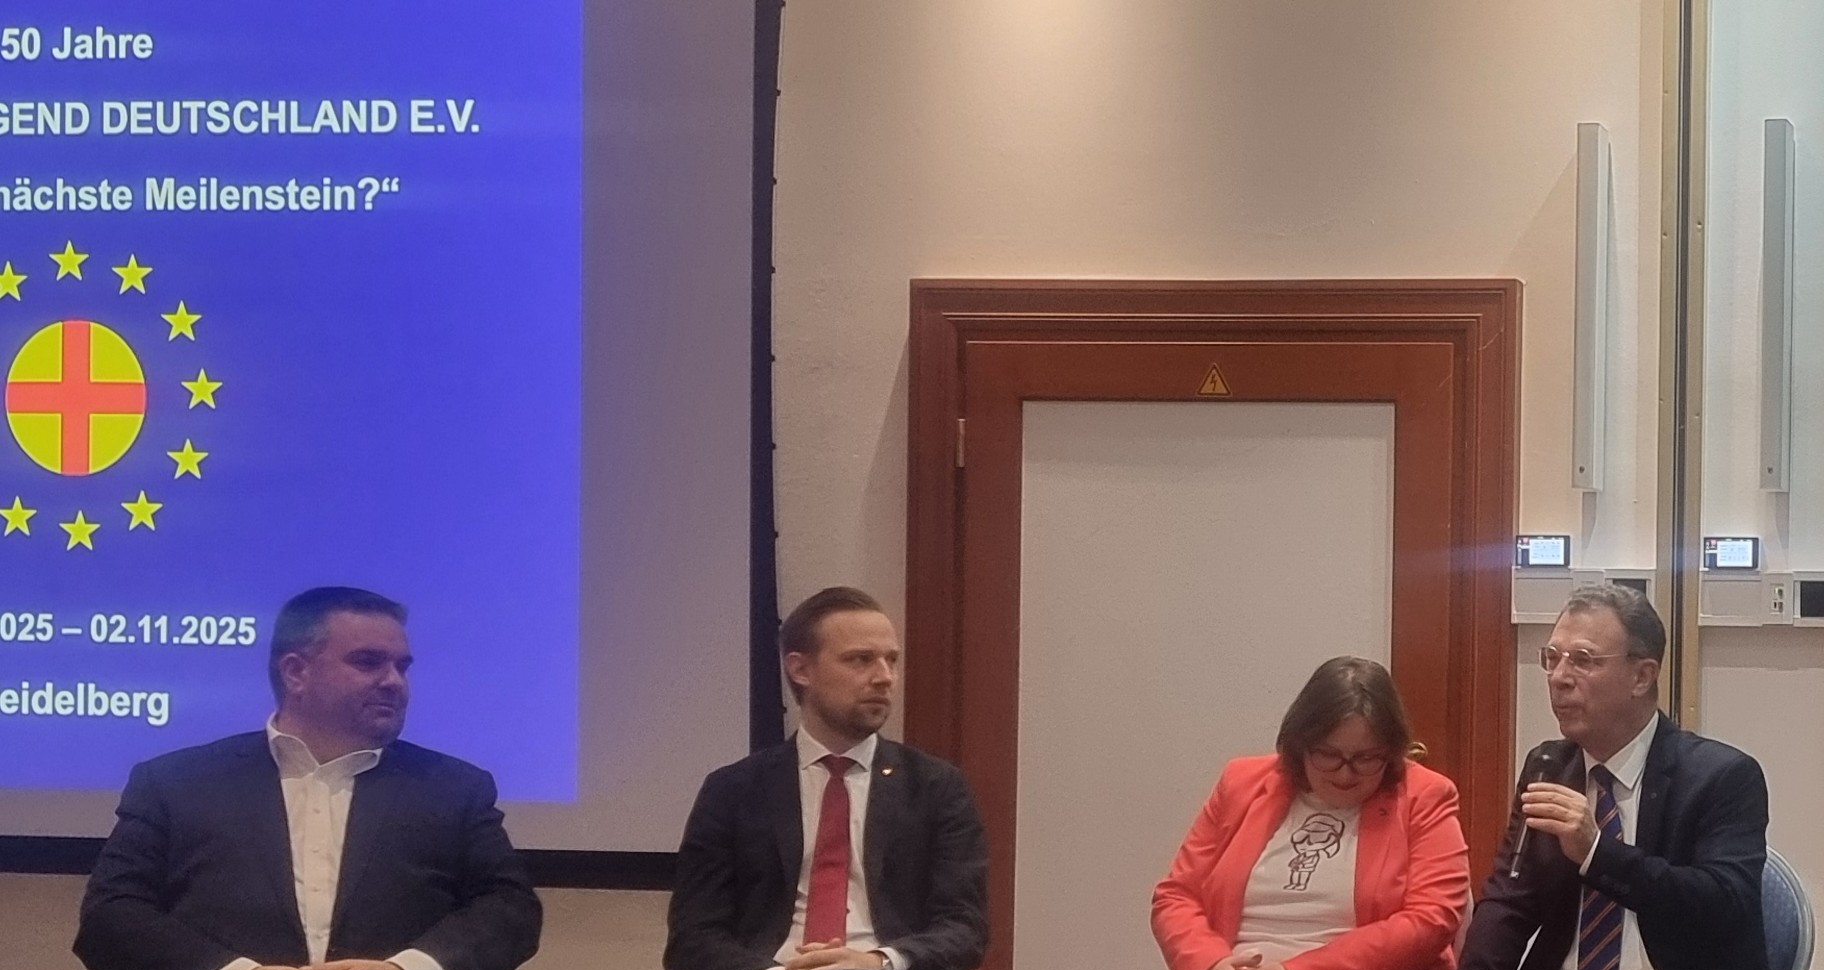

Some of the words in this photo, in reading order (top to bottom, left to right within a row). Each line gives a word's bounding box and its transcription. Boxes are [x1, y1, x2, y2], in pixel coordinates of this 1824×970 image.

[0, 27, 41, 60] 50
[52, 26, 153, 60] Jahre
[103, 99, 398, 134] DEUTSCHLAND
[410, 99, 480, 133] E.V.
[145, 177, 399, 211] Meilenstein?“
[0, 612, 54, 642] 025
[90, 613, 256, 645] 02.11.2025
[0, 681, 170, 726] eidelberg
